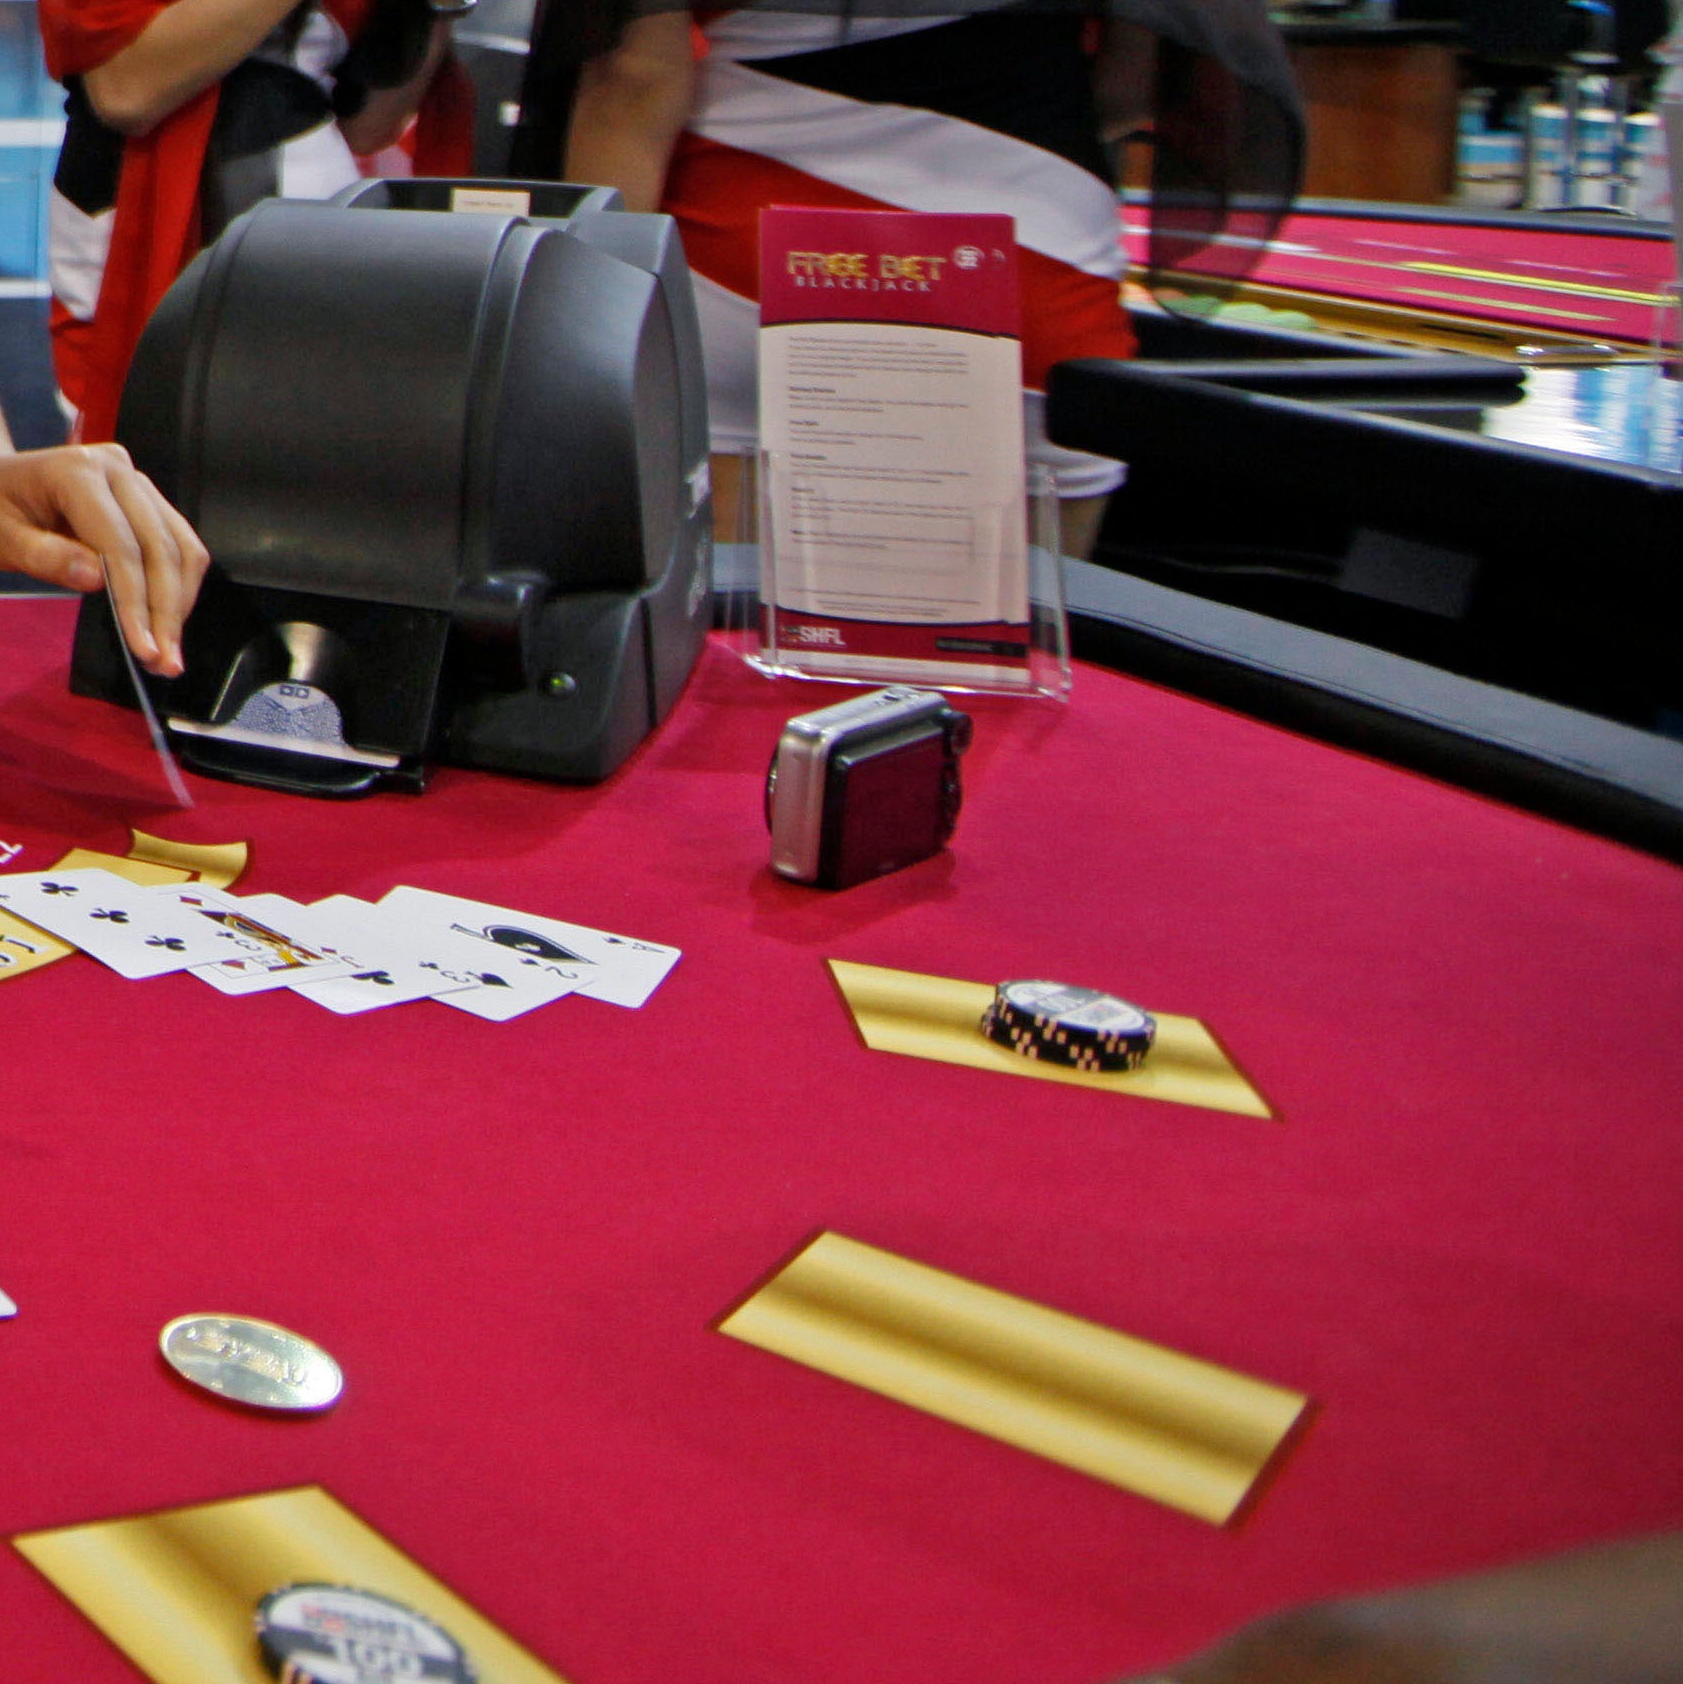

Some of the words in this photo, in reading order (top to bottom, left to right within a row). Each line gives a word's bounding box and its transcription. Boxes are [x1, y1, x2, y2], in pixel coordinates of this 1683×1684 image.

[788, 251, 870, 278] FREE
[879, 254, 948, 281] BET
[794, 276, 932, 293] BLACKJACK
[797, 626, 847, 646] SHFL
